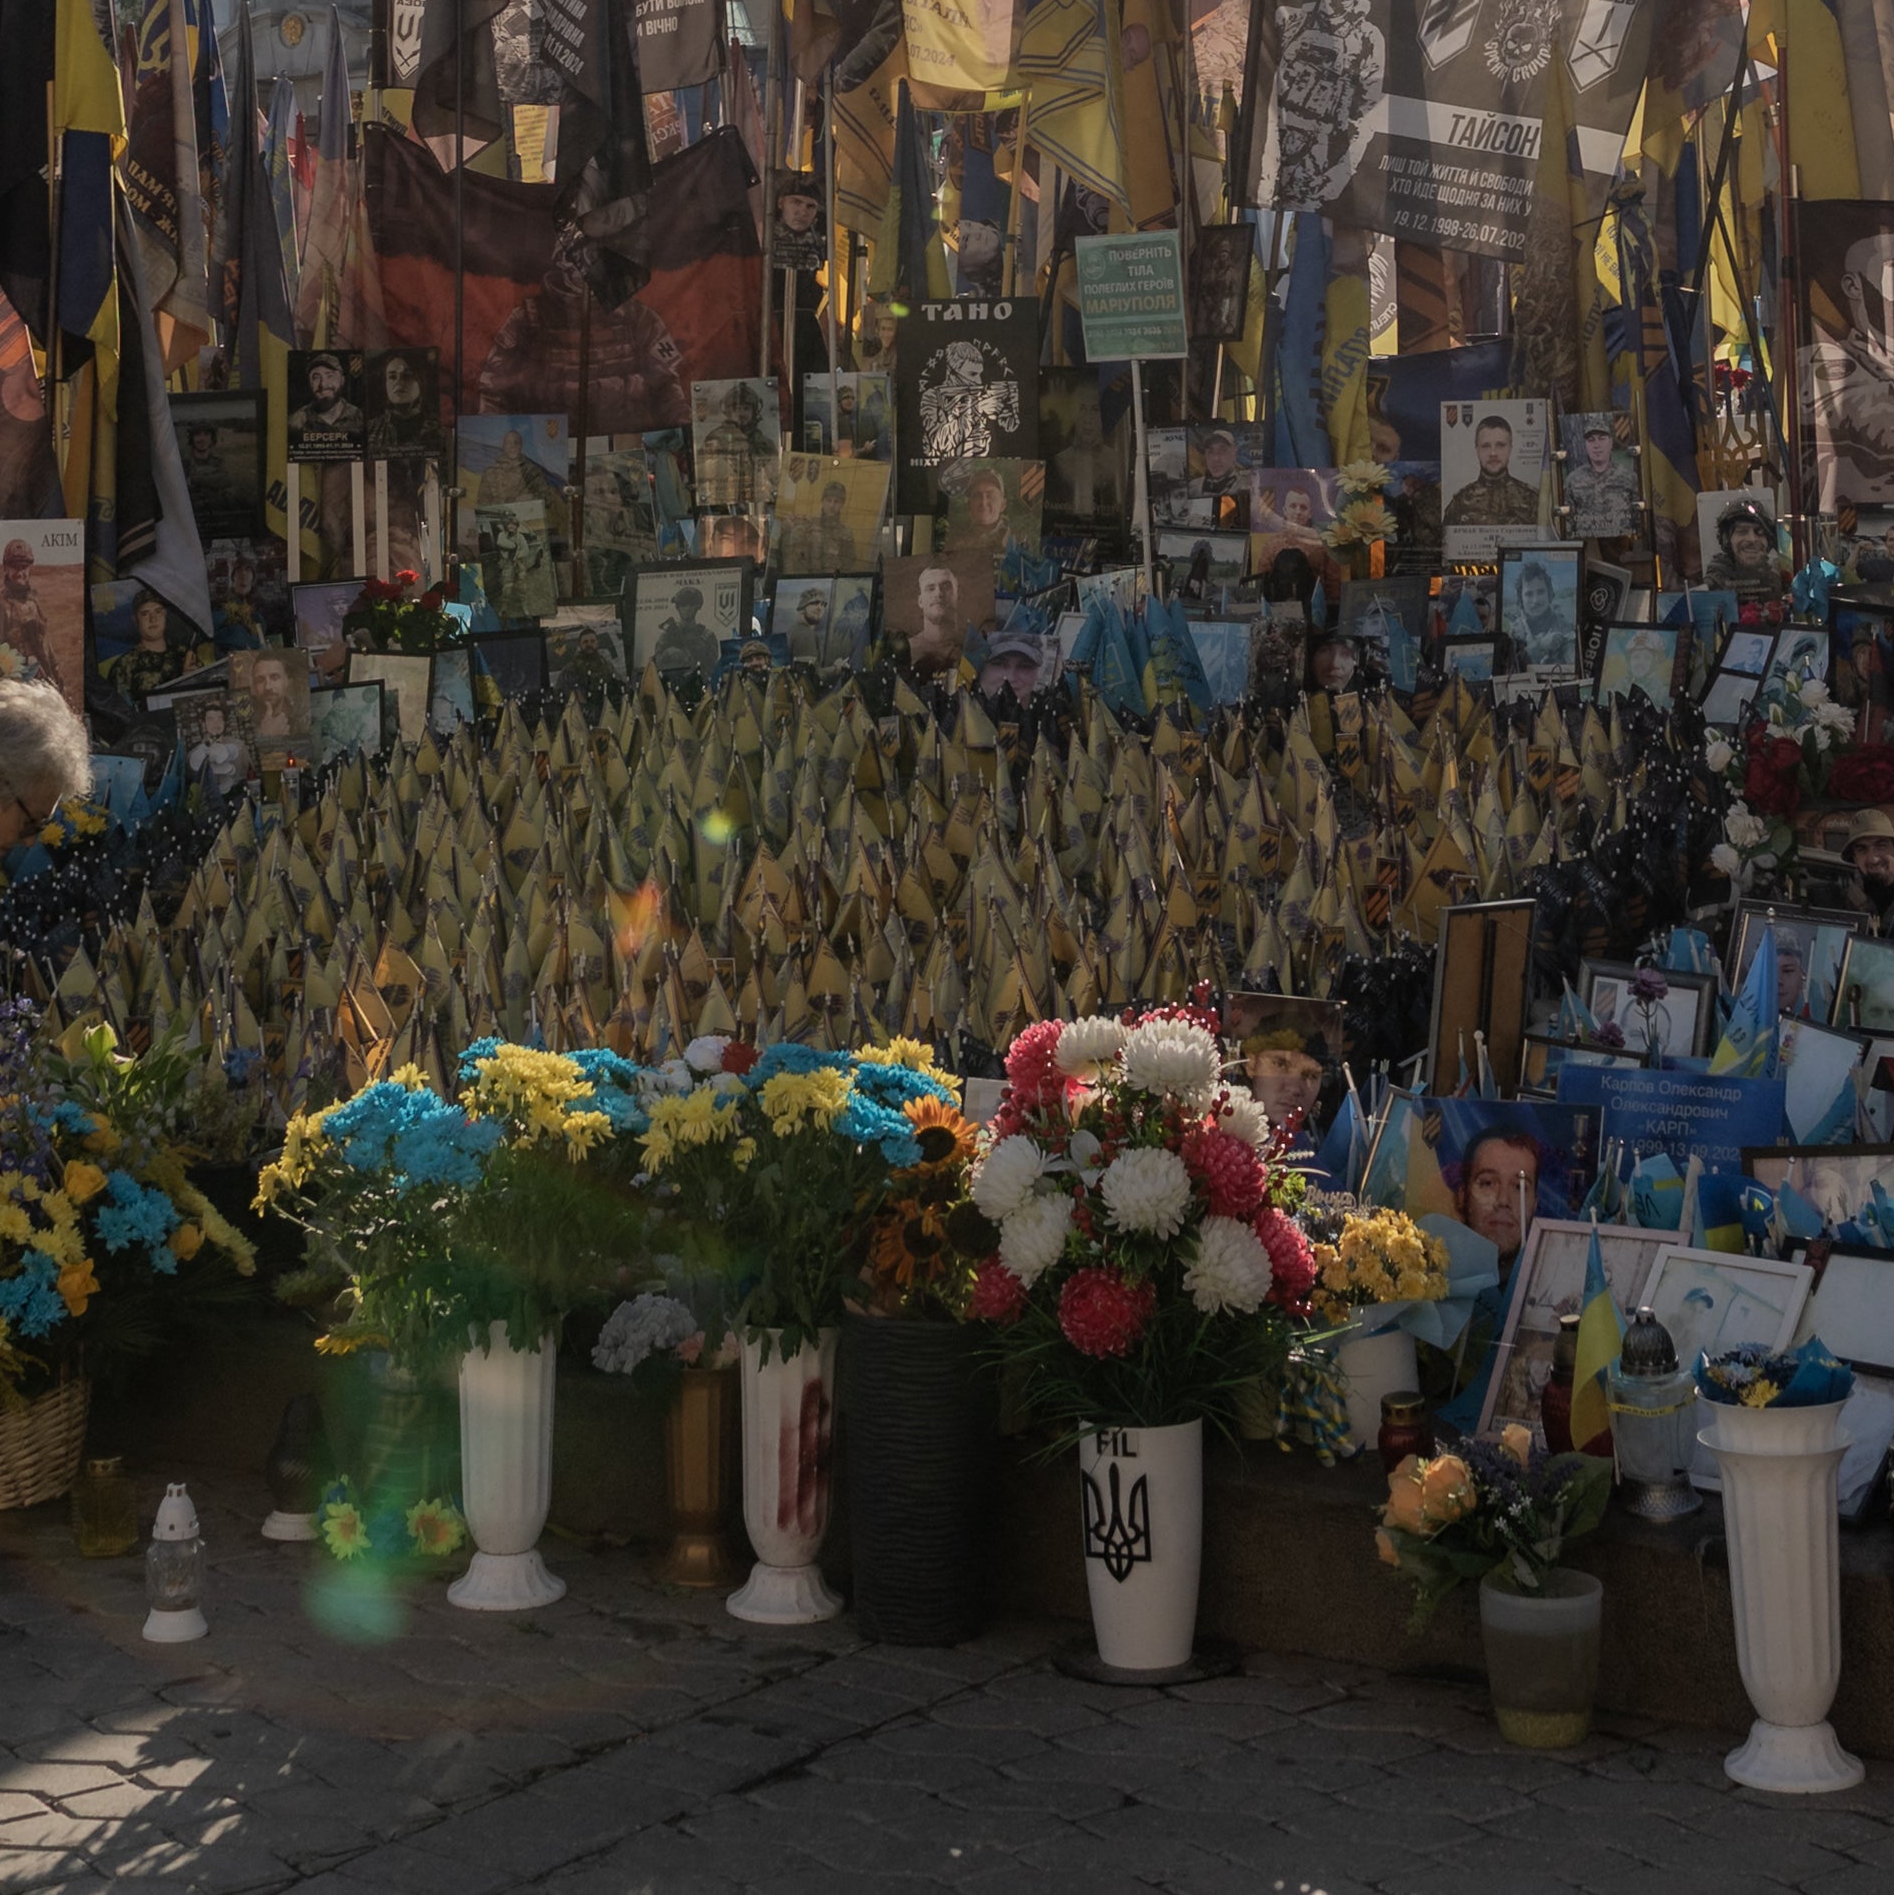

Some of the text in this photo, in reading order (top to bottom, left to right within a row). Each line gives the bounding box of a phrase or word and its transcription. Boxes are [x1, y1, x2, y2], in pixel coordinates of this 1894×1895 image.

[645, 16, 679, 37] ВІЧНО
[1447, 112, 1541, 157] ТАЙСОН
[1378, 155, 1406, 173] ЛИШ
[1407, 158, 1430, 176] ТОЙ
[1429, 162, 1470, 185] ЖИТТЯ
[1480, 170, 1535, 198] СВОБОДИ
[1388, 179, 1413, 196] ХТО
[1413, 182, 1437, 201] ЙДЕ
[1438, 187, 1481, 209] ЩОДНЯ
[1481, 192, 1497, 210] ЗА
[1497, 195, 1523, 214] НИХ
[1393, 209, 1526, 251] 19.12.1998-26.07.202
[1108, 246, 1172, 263] ПОВЕРНІТЬ
[1127, 265, 1154, 277] ТІЛА
[1084, 277, 1175, 295] ПОЛЕГЛИХ ГЕРОЇВ
[921, 301, 1013, 322] ТАНО
[1086, 295, 1175, 315] МАРІУПОЛЯ
[303, 432, 348, 442] БЕРСЕРК
[1601, 1074, 1743, 1102] Карпов Олександр
[1611, 1096, 1729, 1120] Олександрович
[1637, 1119, 1697, 1137] «КАРП»
[1095, 1430, 1139, 1458] FIL
